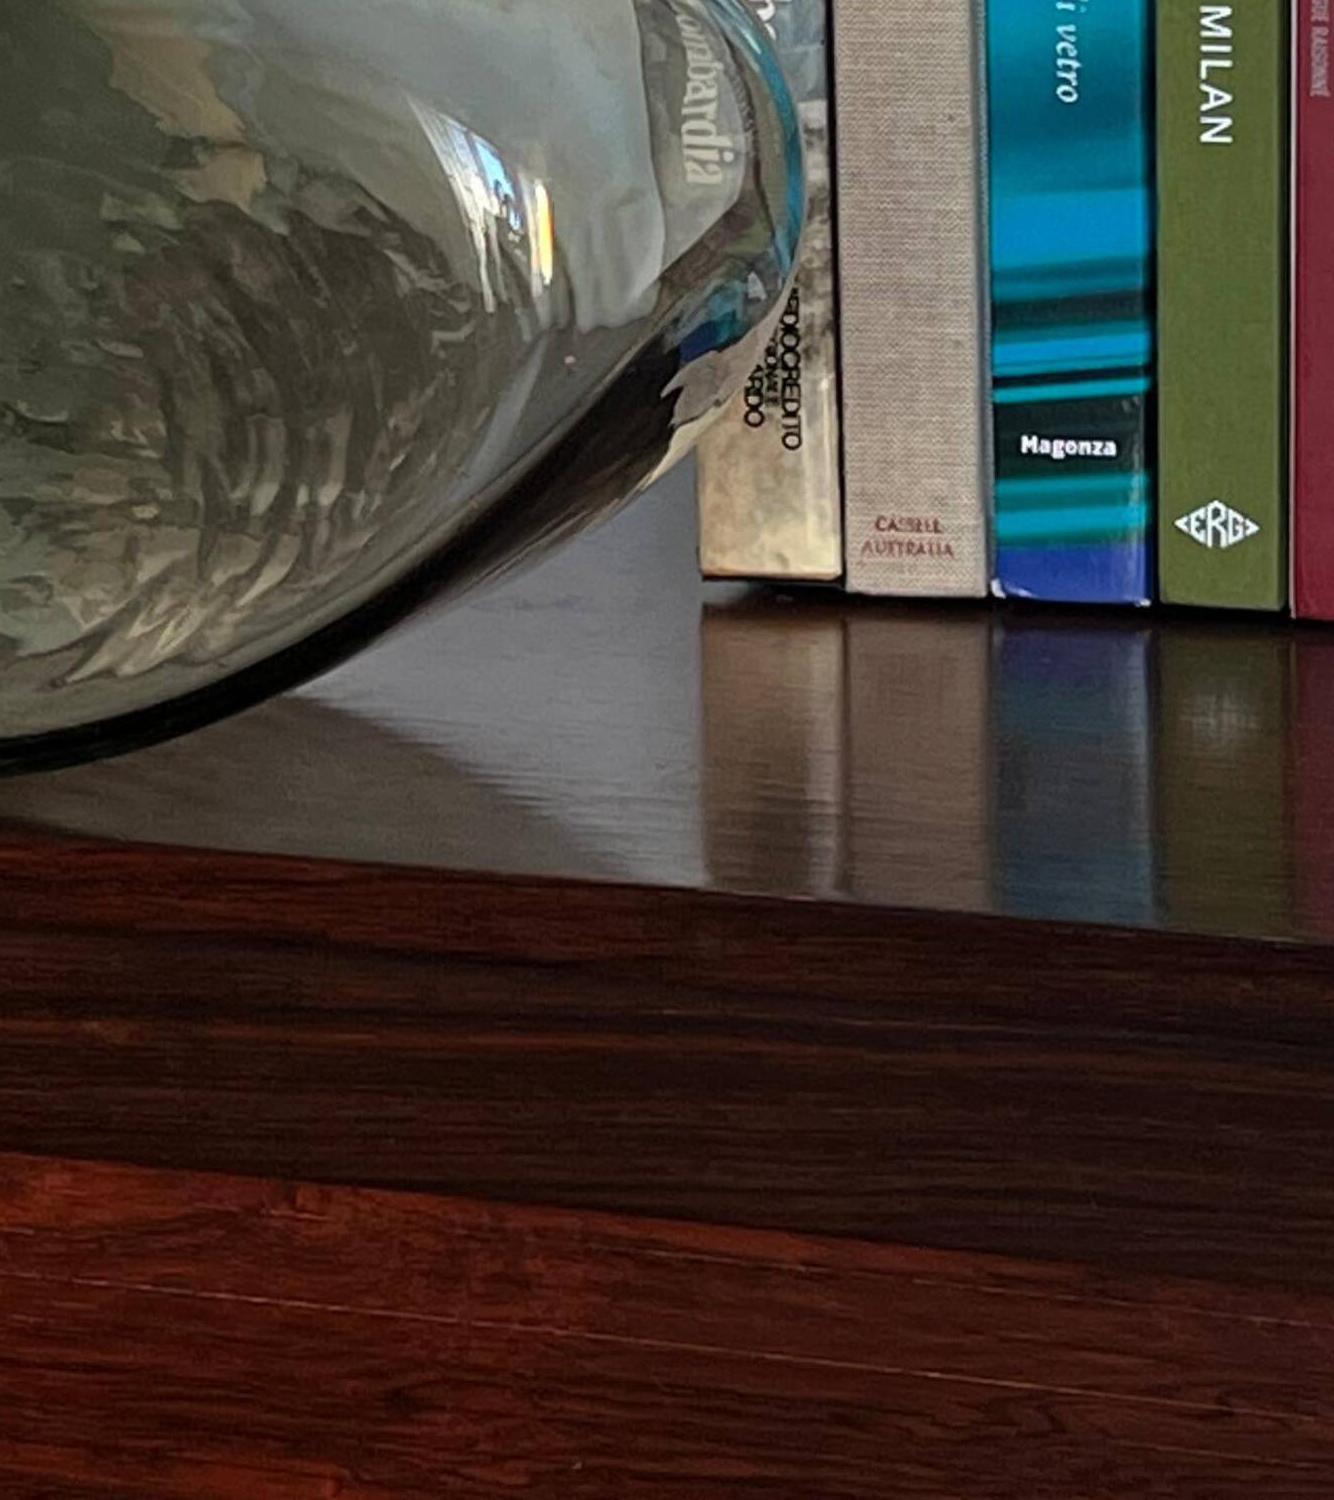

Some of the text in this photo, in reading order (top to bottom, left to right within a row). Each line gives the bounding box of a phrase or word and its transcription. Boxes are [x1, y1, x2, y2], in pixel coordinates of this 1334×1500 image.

[1055, 24, 1082, 104] vetro
[1198, 4, 1233, 145] MILAN
[1020, 434, 1118, 460] Magonza
